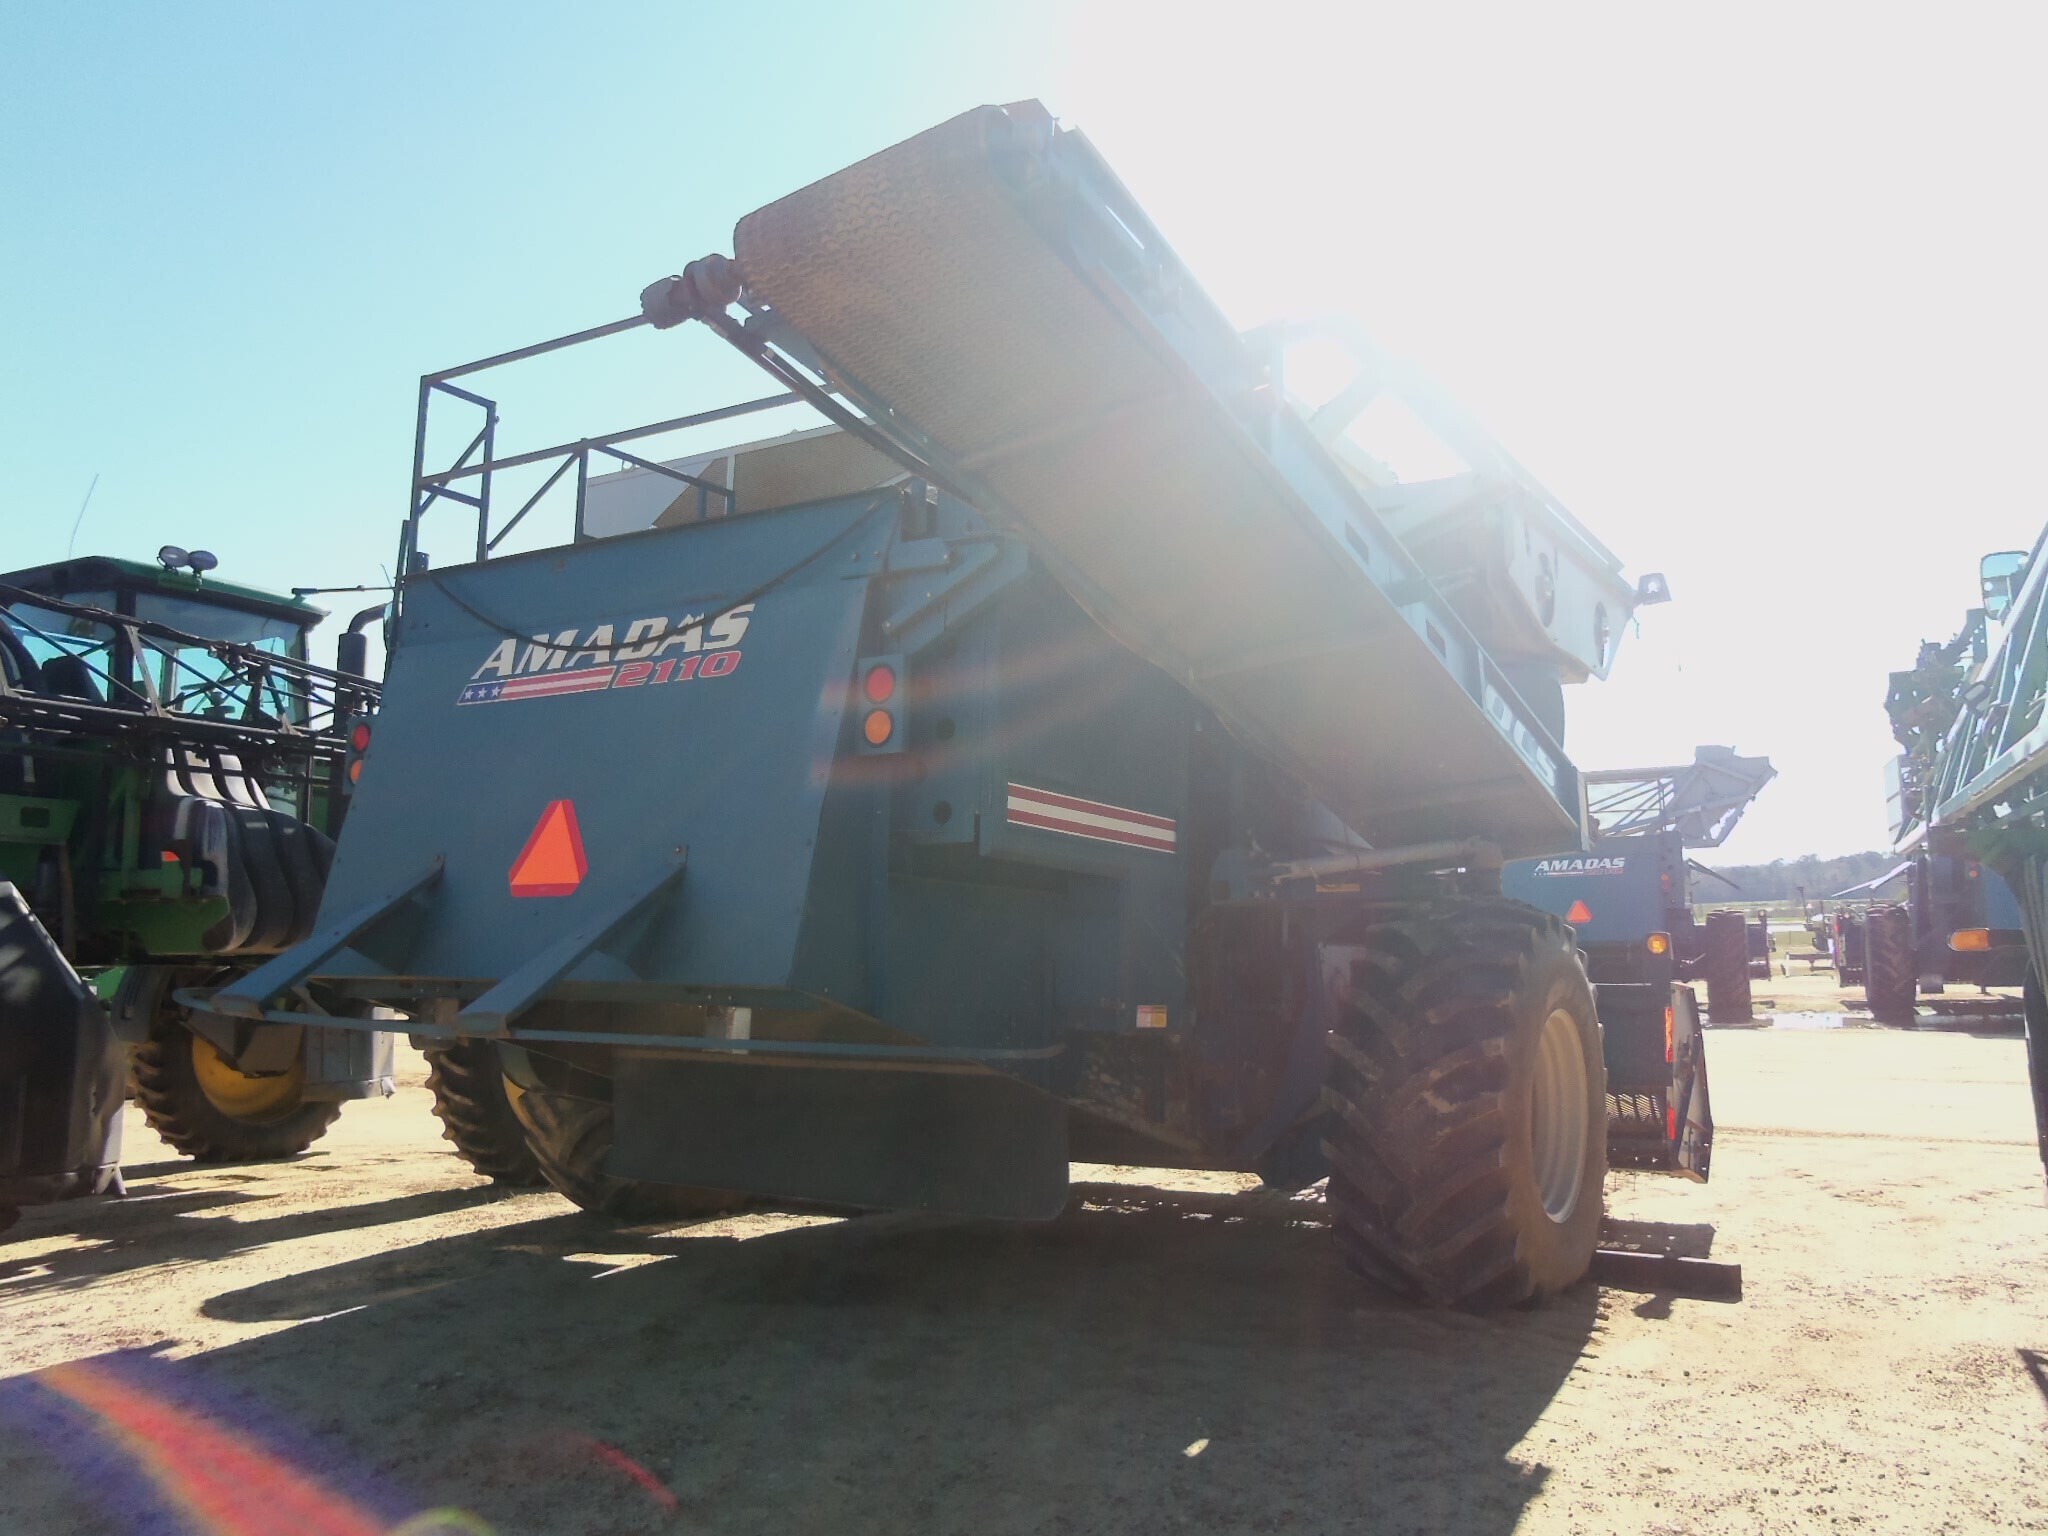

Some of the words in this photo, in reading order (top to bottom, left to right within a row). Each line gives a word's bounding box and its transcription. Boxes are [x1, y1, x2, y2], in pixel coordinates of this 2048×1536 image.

[470, 603, 756, 680] AMADAS
[611, 650, 742, 689] 2110
[1534, 857, 1626, 872] AMADAS
